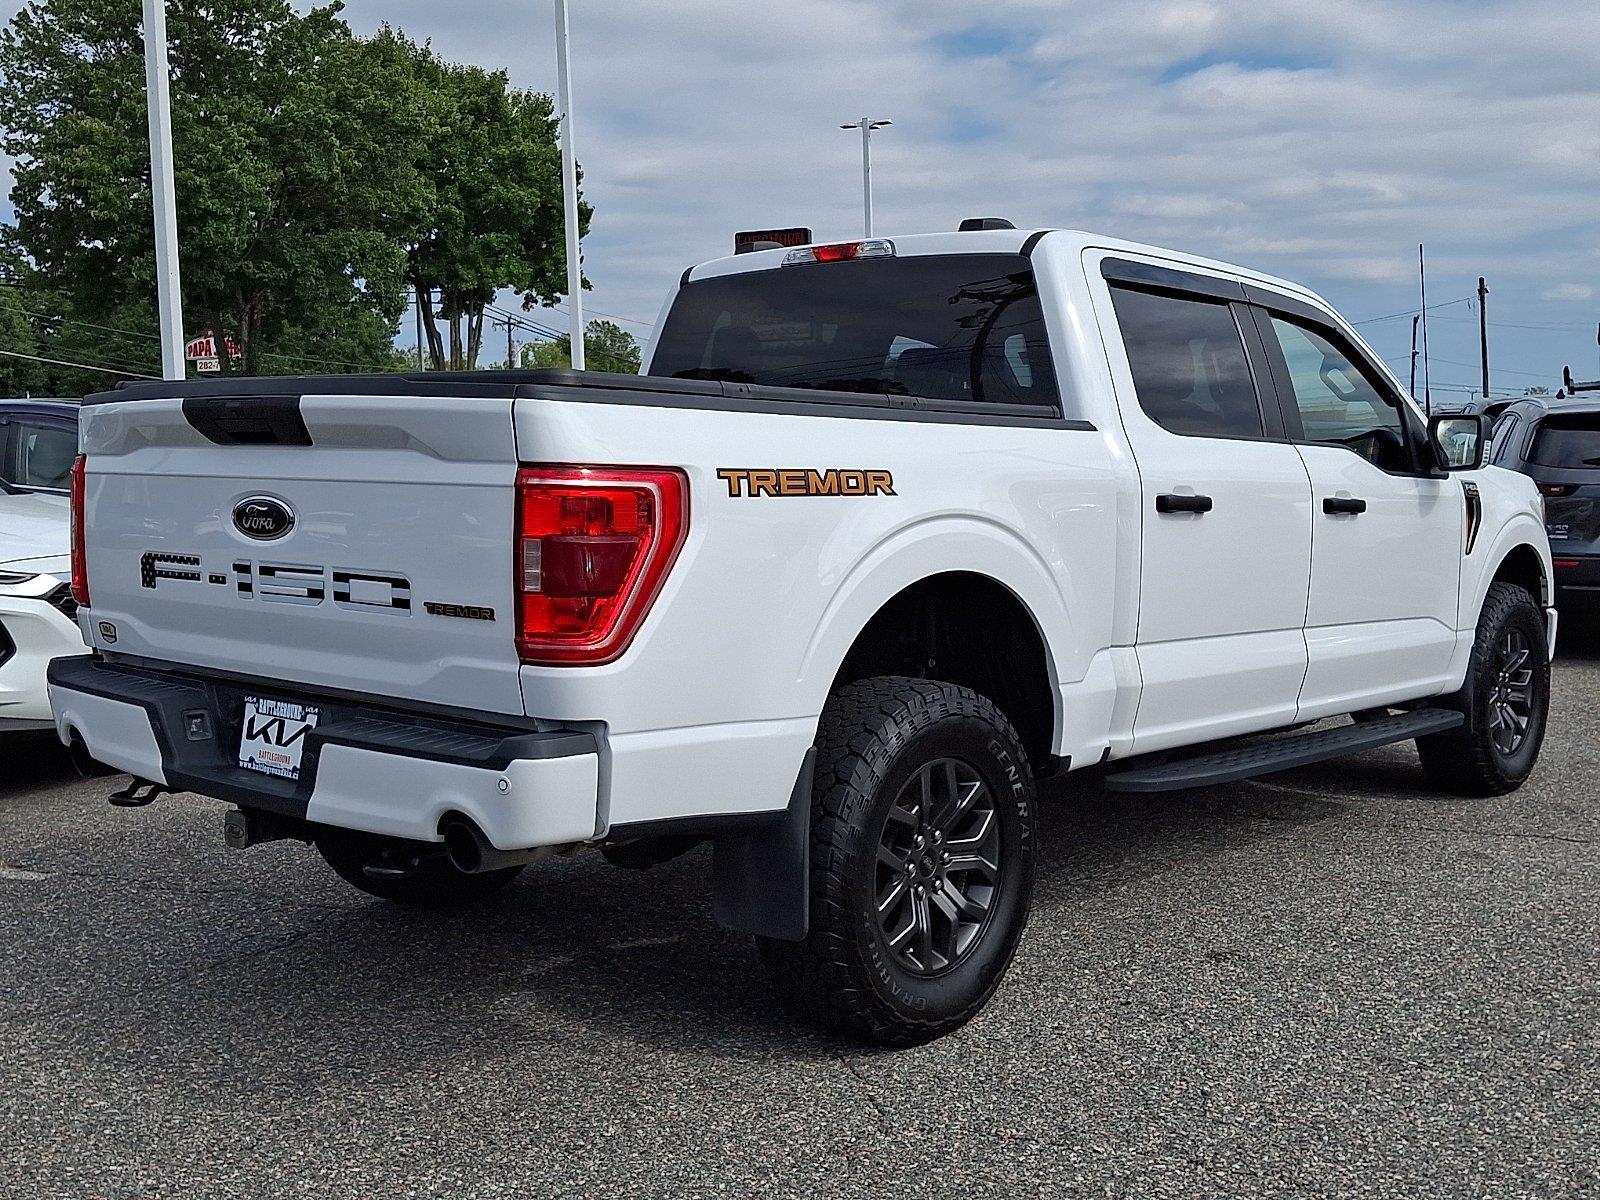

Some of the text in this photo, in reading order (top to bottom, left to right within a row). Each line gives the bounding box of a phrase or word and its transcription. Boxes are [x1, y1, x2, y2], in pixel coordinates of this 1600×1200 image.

[188, 340, 212, 357] PAPA
[716, 468, 898, 497] TREMOR
[140, 552, 413, 617] F-150
[424, 602, 496, 621] TREMOR
[258, 749, 292, 764] BATTLEGROUND
[988, 739, 1031, 861] GENERAL
